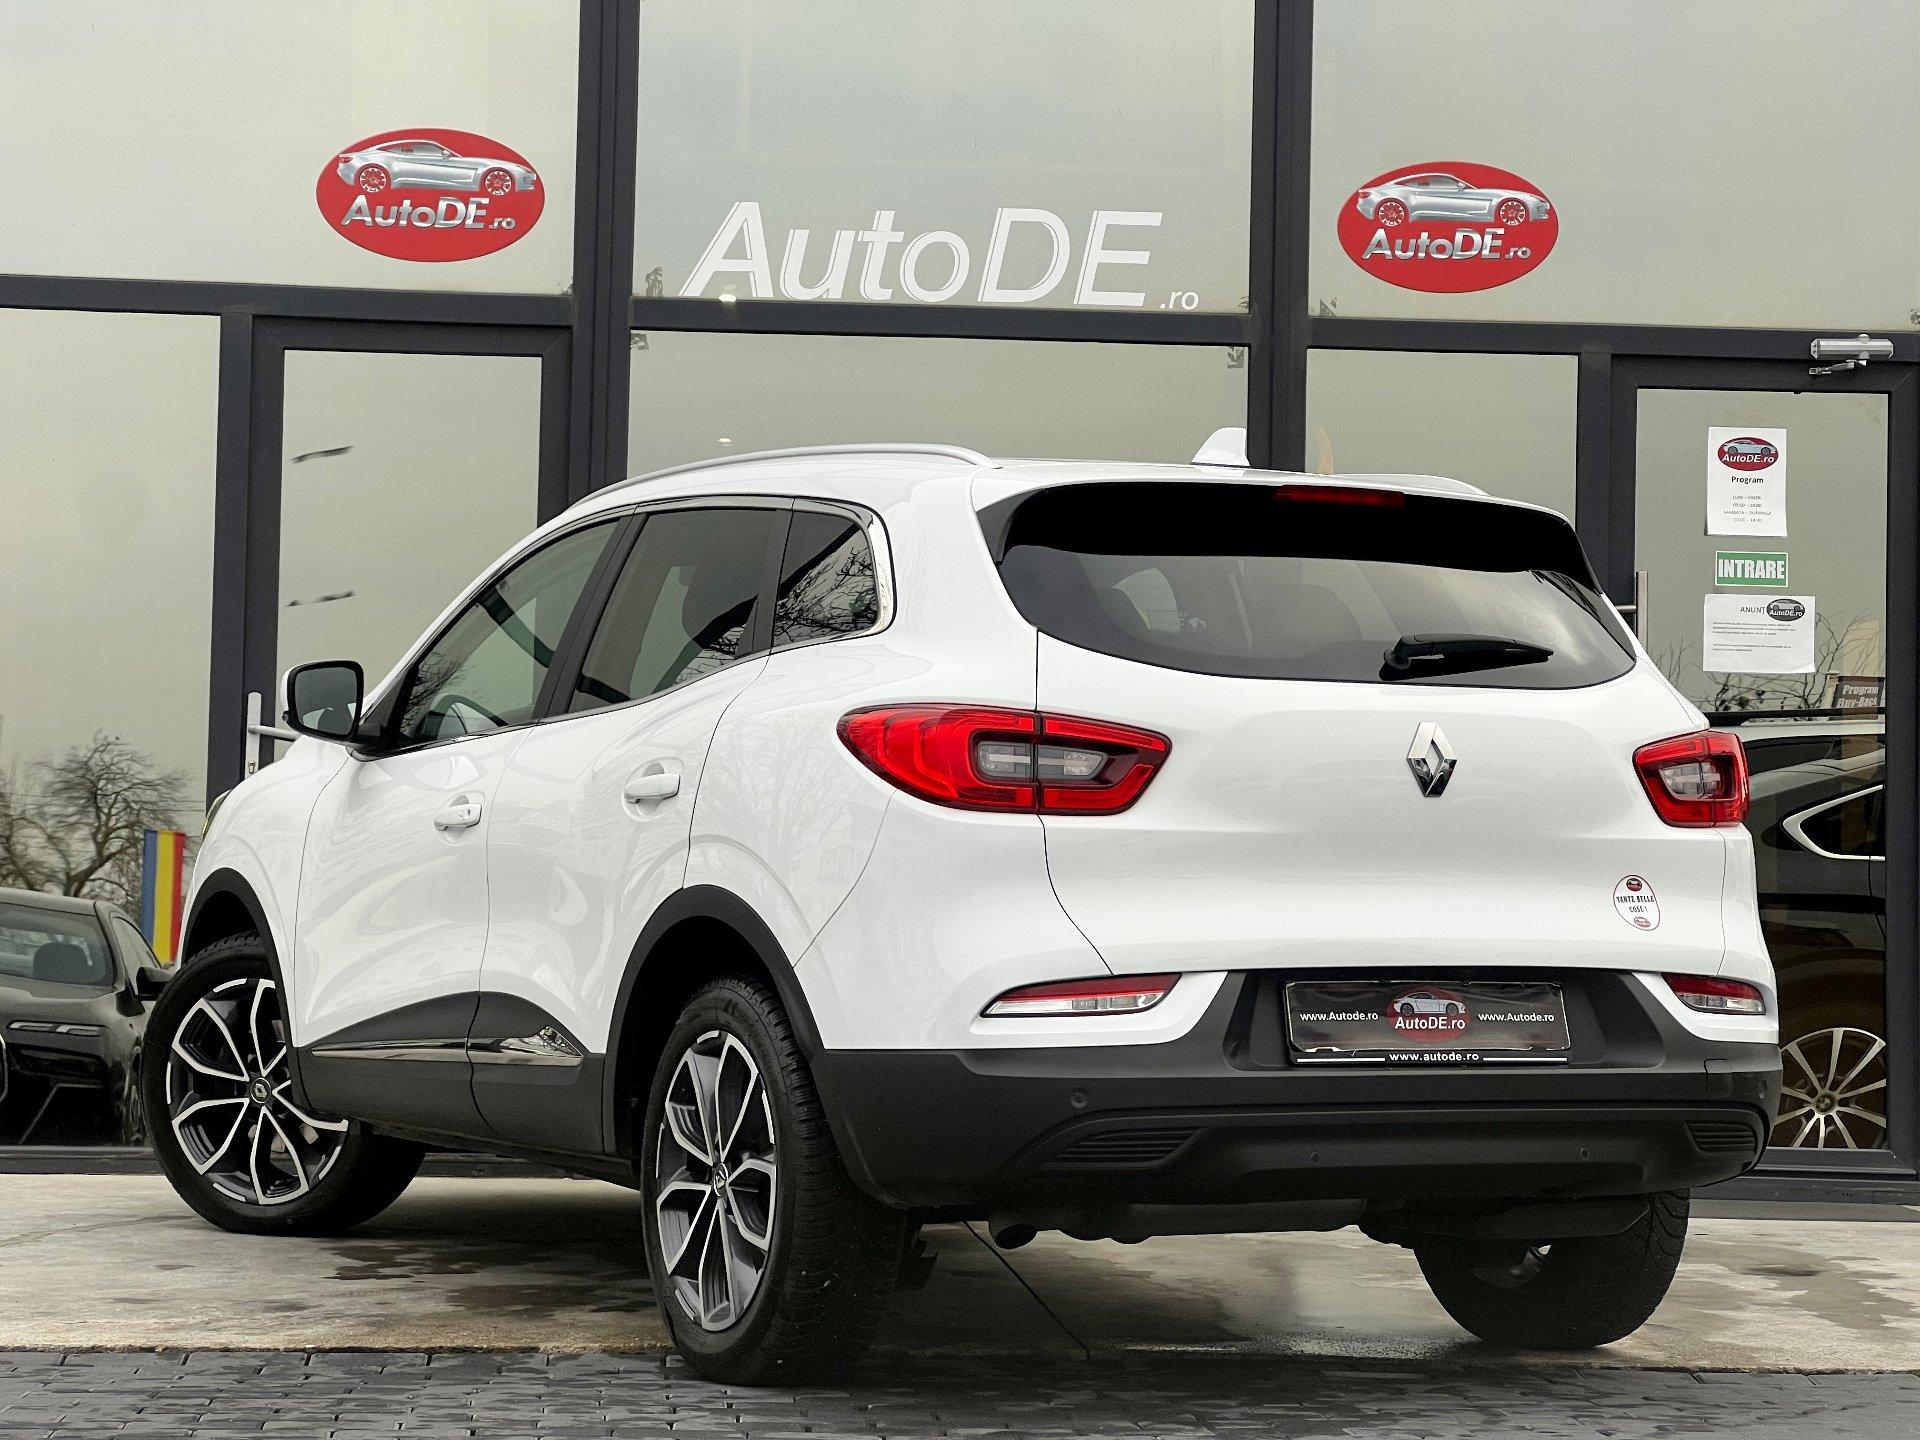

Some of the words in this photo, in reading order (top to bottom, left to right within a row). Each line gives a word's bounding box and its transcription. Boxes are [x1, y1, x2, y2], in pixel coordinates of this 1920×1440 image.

[1722, 453, 1775, 463] AutoDE.ro
[1731, 476, 1764, 485] Program
[1717, 558, 1785, 580] INTRARE
[1769, 608, 1803, 617] AutoDE.ro
[1842, 684, 1879, 695] Program
[1616, 895, 1636, 903] TANTE
[1636, 895, 1655, 903] BELLE
[1299, 1010, 1379, 1022] www.Autode.ro
[1478, 1011, 1555, 1023] www.Autode.ro
[1394, 1016, 1466, 1030] AutoDE.ro
[1389, 1051, 1480, 1063] www.autode.ro
